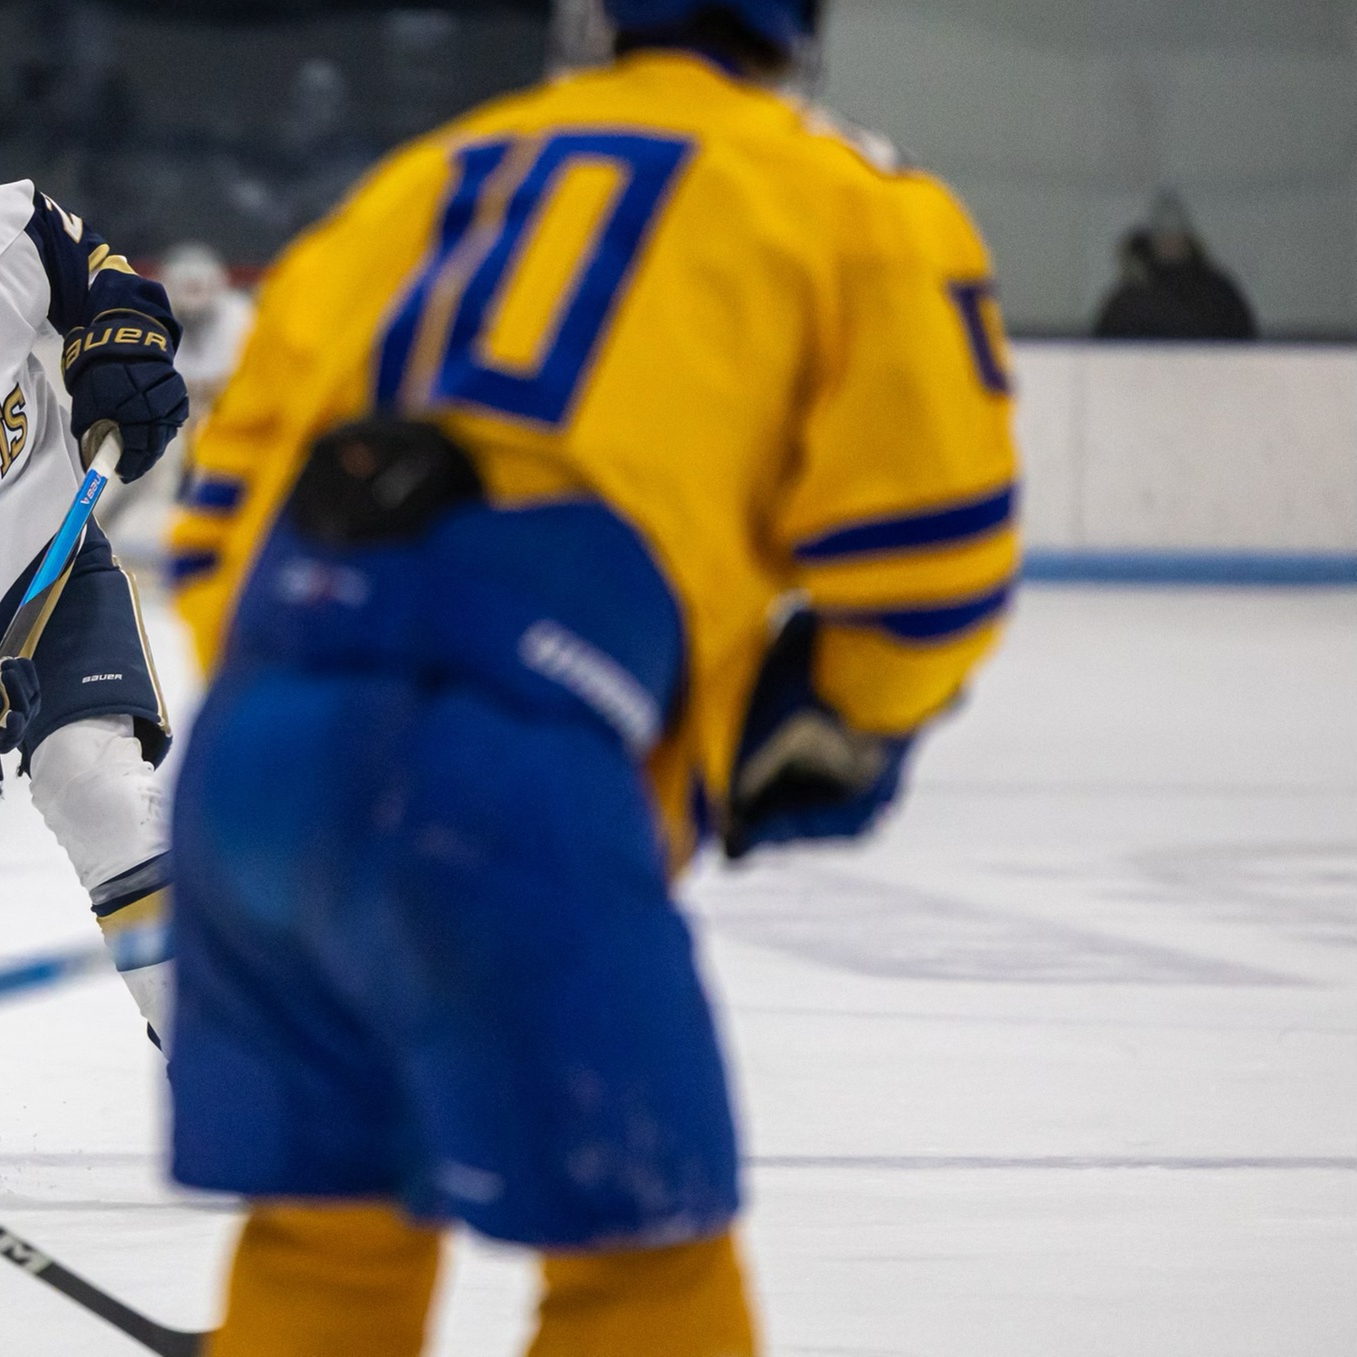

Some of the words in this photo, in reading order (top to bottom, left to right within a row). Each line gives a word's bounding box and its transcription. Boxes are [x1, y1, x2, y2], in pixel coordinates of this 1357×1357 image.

[372, 130, 698, 430] 10
[65, 327, 167, 370] AUER
[82, 673, 123, 684] BAUER
